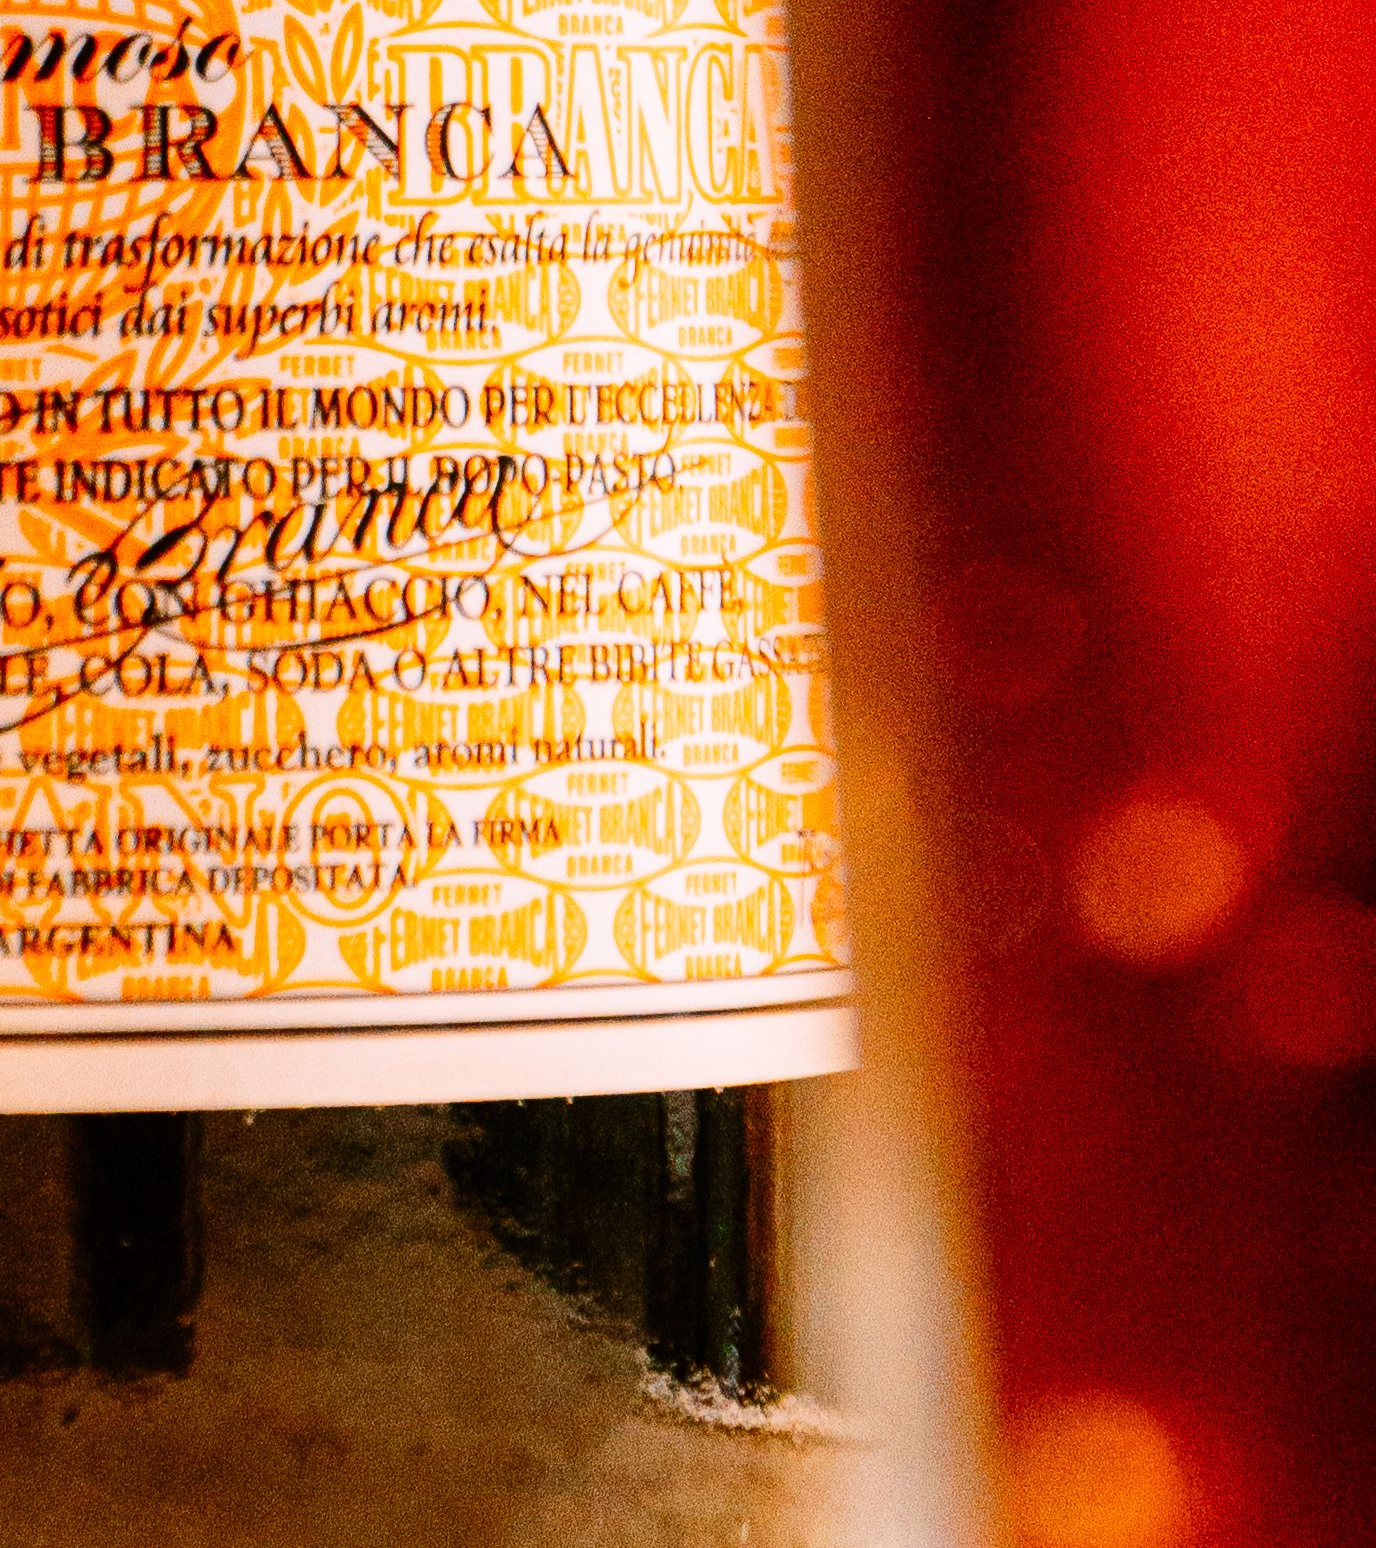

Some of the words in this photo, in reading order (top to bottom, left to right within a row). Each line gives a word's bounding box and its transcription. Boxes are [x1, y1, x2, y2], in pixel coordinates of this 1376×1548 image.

[24, 101, 578, 185] BRANCA
[3, 210, 45, 272] di
[63, 209, 380, 294] trasformazione
[392, 209, 456, 266] che
[468, 209, 569, 265] esalta
[582, 209, 612, 264] la
[118, 282, 188, 339] dai
[202, 282, 354, 361] superbi
[371, 287, 497, 335] aromi.
[34, 388, 82, 434] IN
[92, 386, 247, 434] TUTTO
[259, 386, 298, 433] IL
[309, 383, 471, 431] MONDO
[482, 382, 555, 428] PER
[52, 457, 277, 504] INDICATO
[290, 454, 372, 500] PER
[384, 454, 422, 498] IL
[73, 578, 200, 627] CON
[219, 573, 504, 624] GHIACCIO,
[521, 571, 597, 618] NEL
[78, 652, 229, 700] COLA,
[244, 649, 379, 696] SODA
[393, 648, 428, 692] O
[441, 645, 569, 688] ALTRE
[588, 641, 704, 685] BIBITE
[14, 732, 190, 783] vegetali,
[205, 728, 400, 776] zucchero,
[412, 726, 520, 771] aromi
[532, 716, 667, 766] naturali.
[114, 823, 299, 857] ORIGINALE
[309, 821, 415, 852] PORTA
[425, 819, 464, 849] LA
[472, 817, 563, 848] FIRMA
[26, 865, 196, 899] FABBRICA
